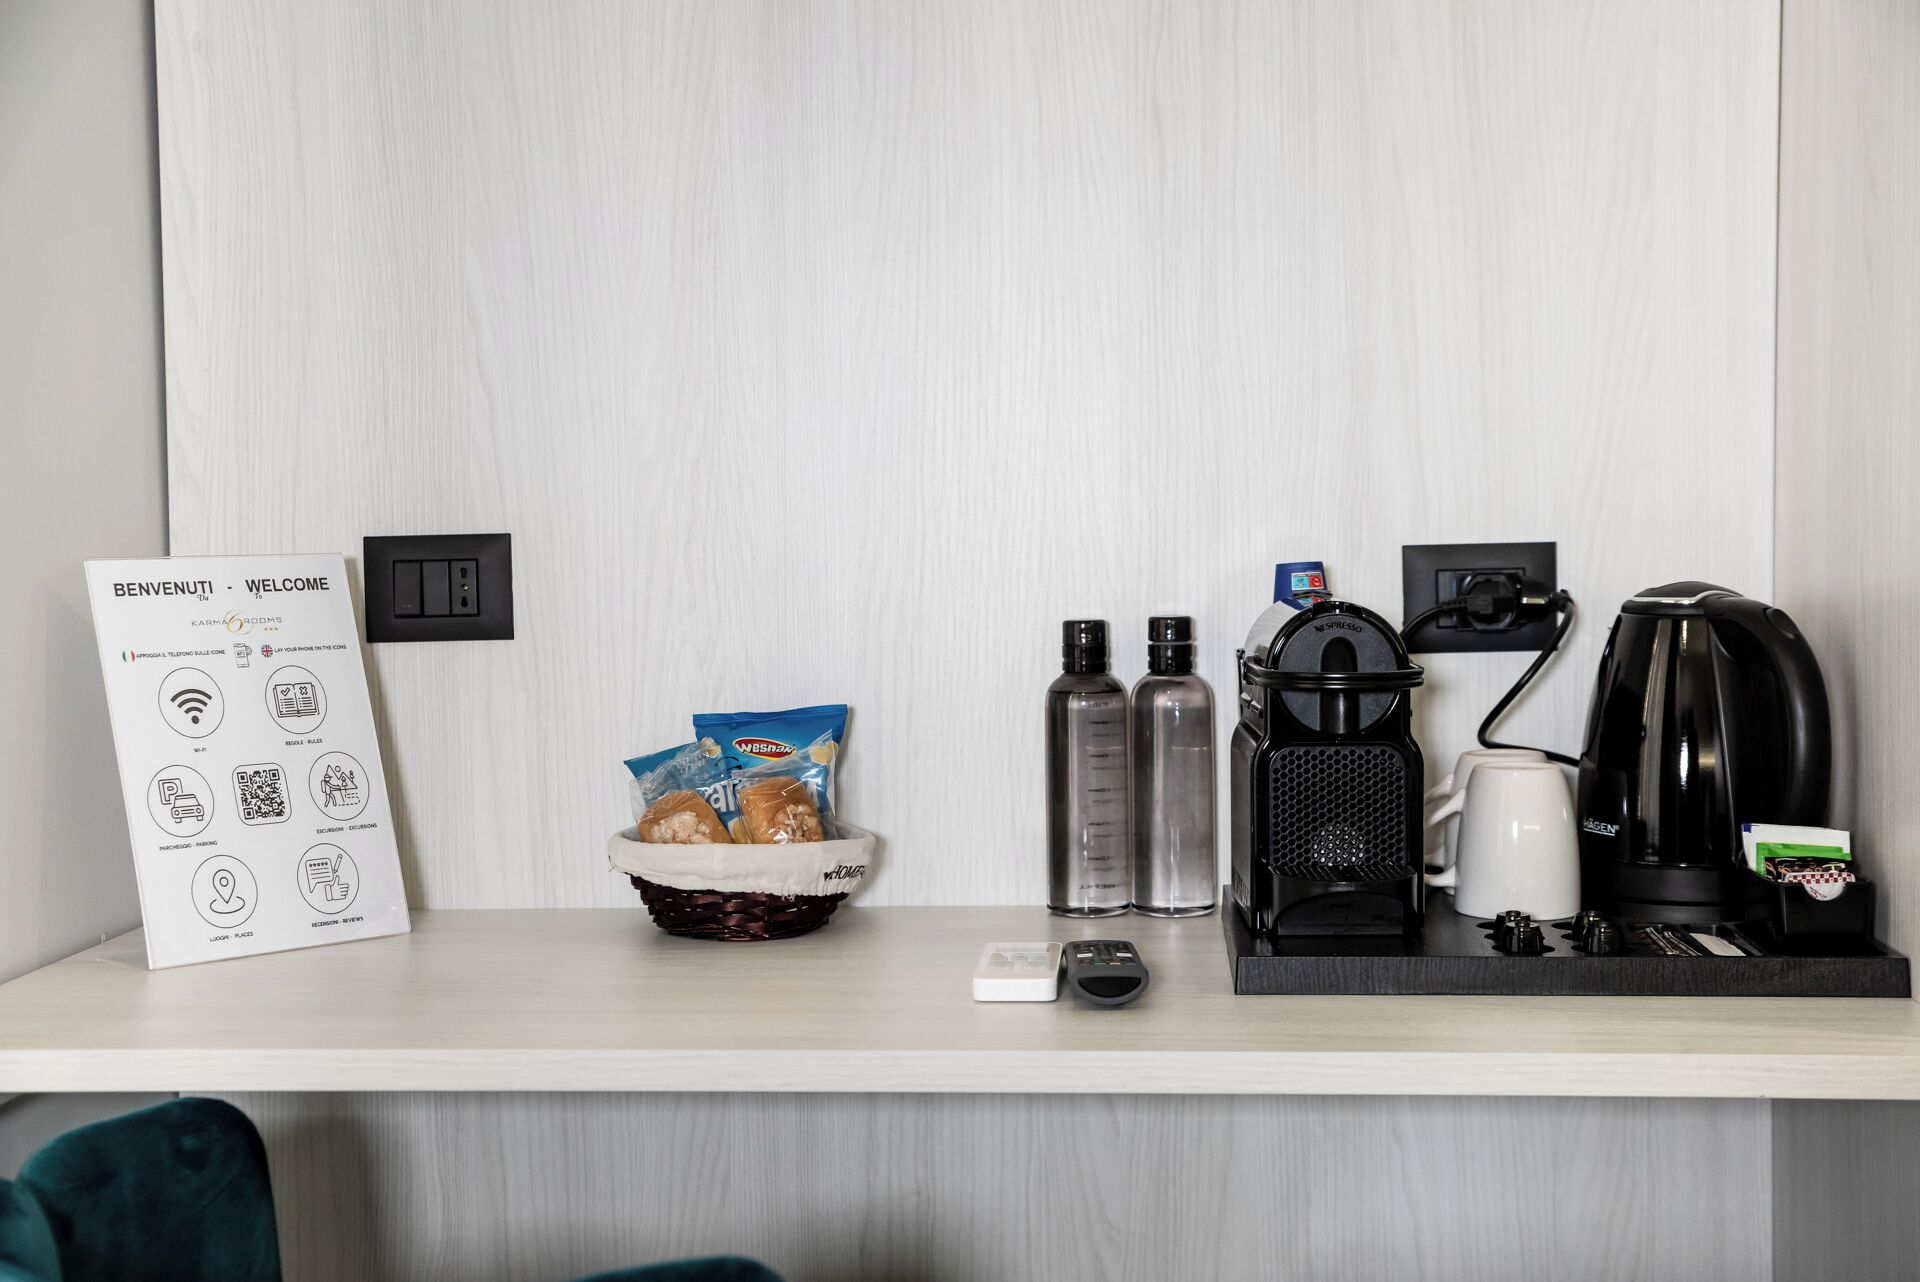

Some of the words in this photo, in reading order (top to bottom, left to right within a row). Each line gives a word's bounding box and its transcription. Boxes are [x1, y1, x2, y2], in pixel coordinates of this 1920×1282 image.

[113, 580, 213, 597] BENVENUTI
[245, 577, 329, 592] WELCOME
[243, 616, 283, 624] ROOMS
[1314, 621, 1363, 632] NESPRESSO
[316, 826, 344, 834] ESCURSIONI
[159, 843, 192, 851] PARCHEGGIO
